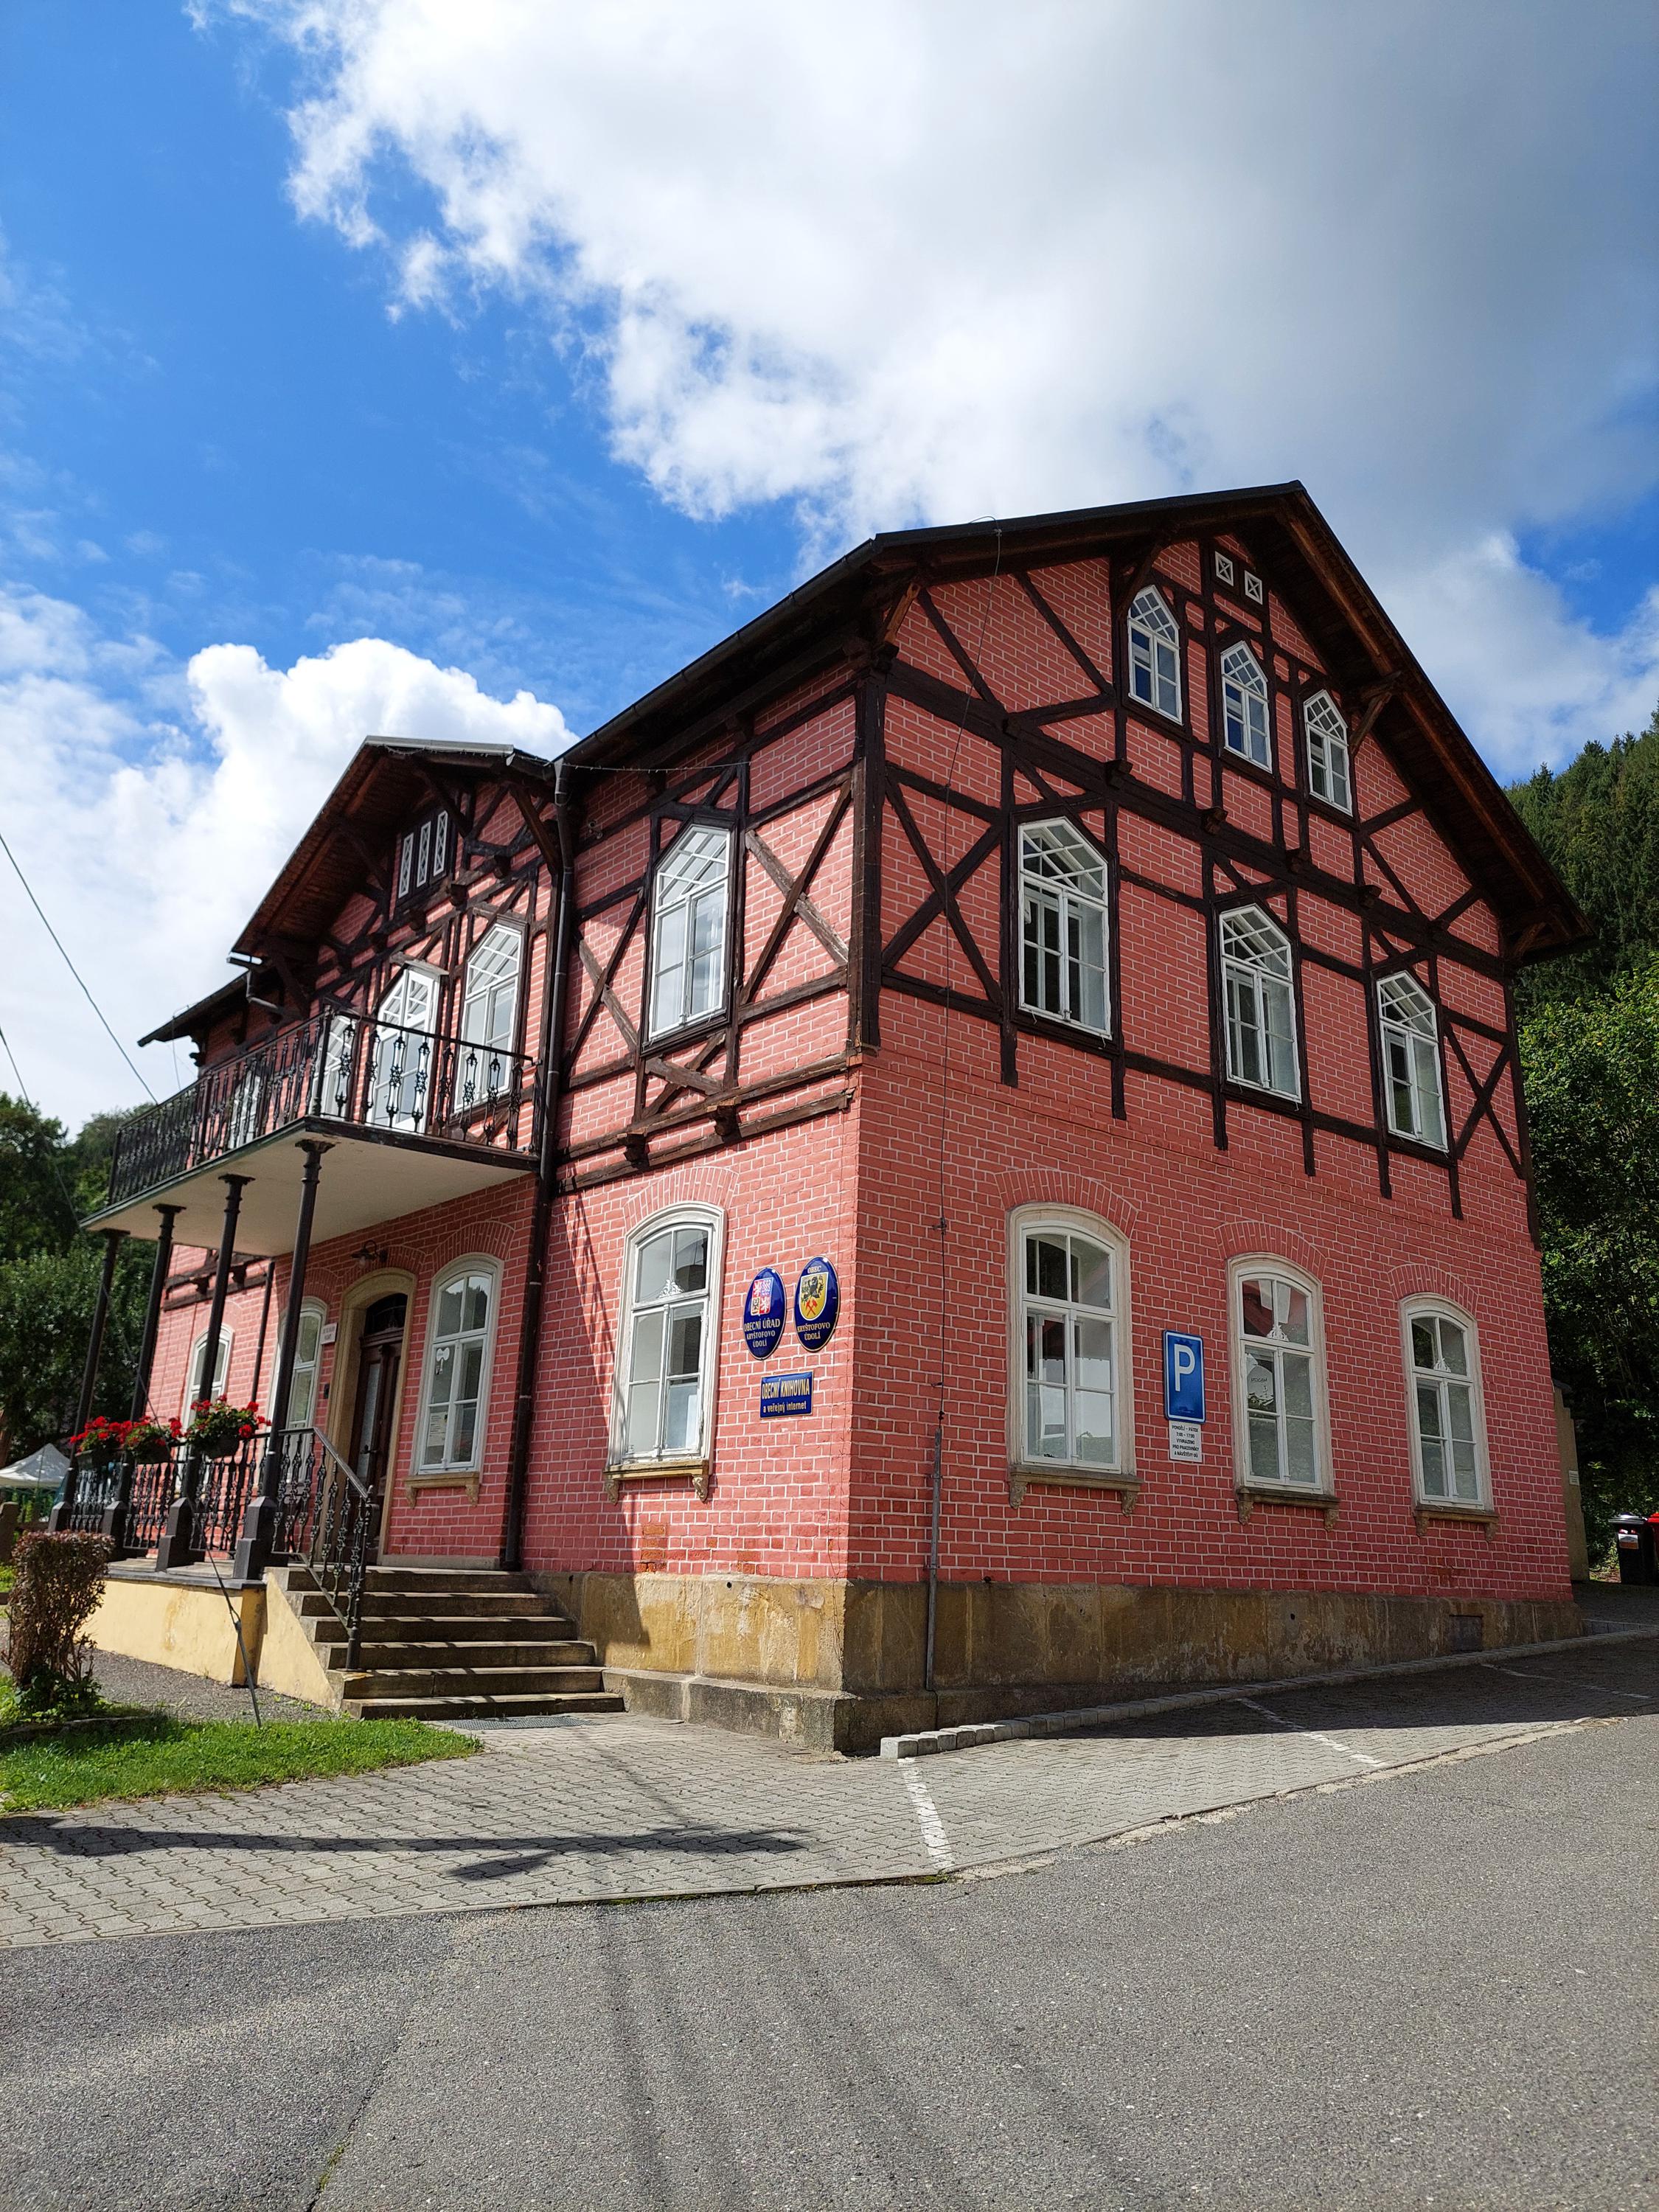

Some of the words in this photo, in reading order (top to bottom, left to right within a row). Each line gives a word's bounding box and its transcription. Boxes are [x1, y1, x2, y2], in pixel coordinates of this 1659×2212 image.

[807, 1265, 821, 1273] OBEC
[744, 1318, 761, 1332] OBECNÍ
[762, 1318, 780, 1328] ÚŘAD
[797, 1322, 830, 1332] KRYŠTOFOVO
[747, 1330, 775, 1340] KRYŠTOFOVO
[804, 1331, 821, 1340] ÚDOLÍ
[753, 1338, 767, 1347] ÚDOLÍ
[1174, 1343, 1196, 1391] P
[762, 1378, 781, 1399] OBECNÍ
[781, 1379, 810, 1397] KNIHOVNA
[768, 1402, 785, 1413] veřejný
[787, 1401, 806, 1411] internet
